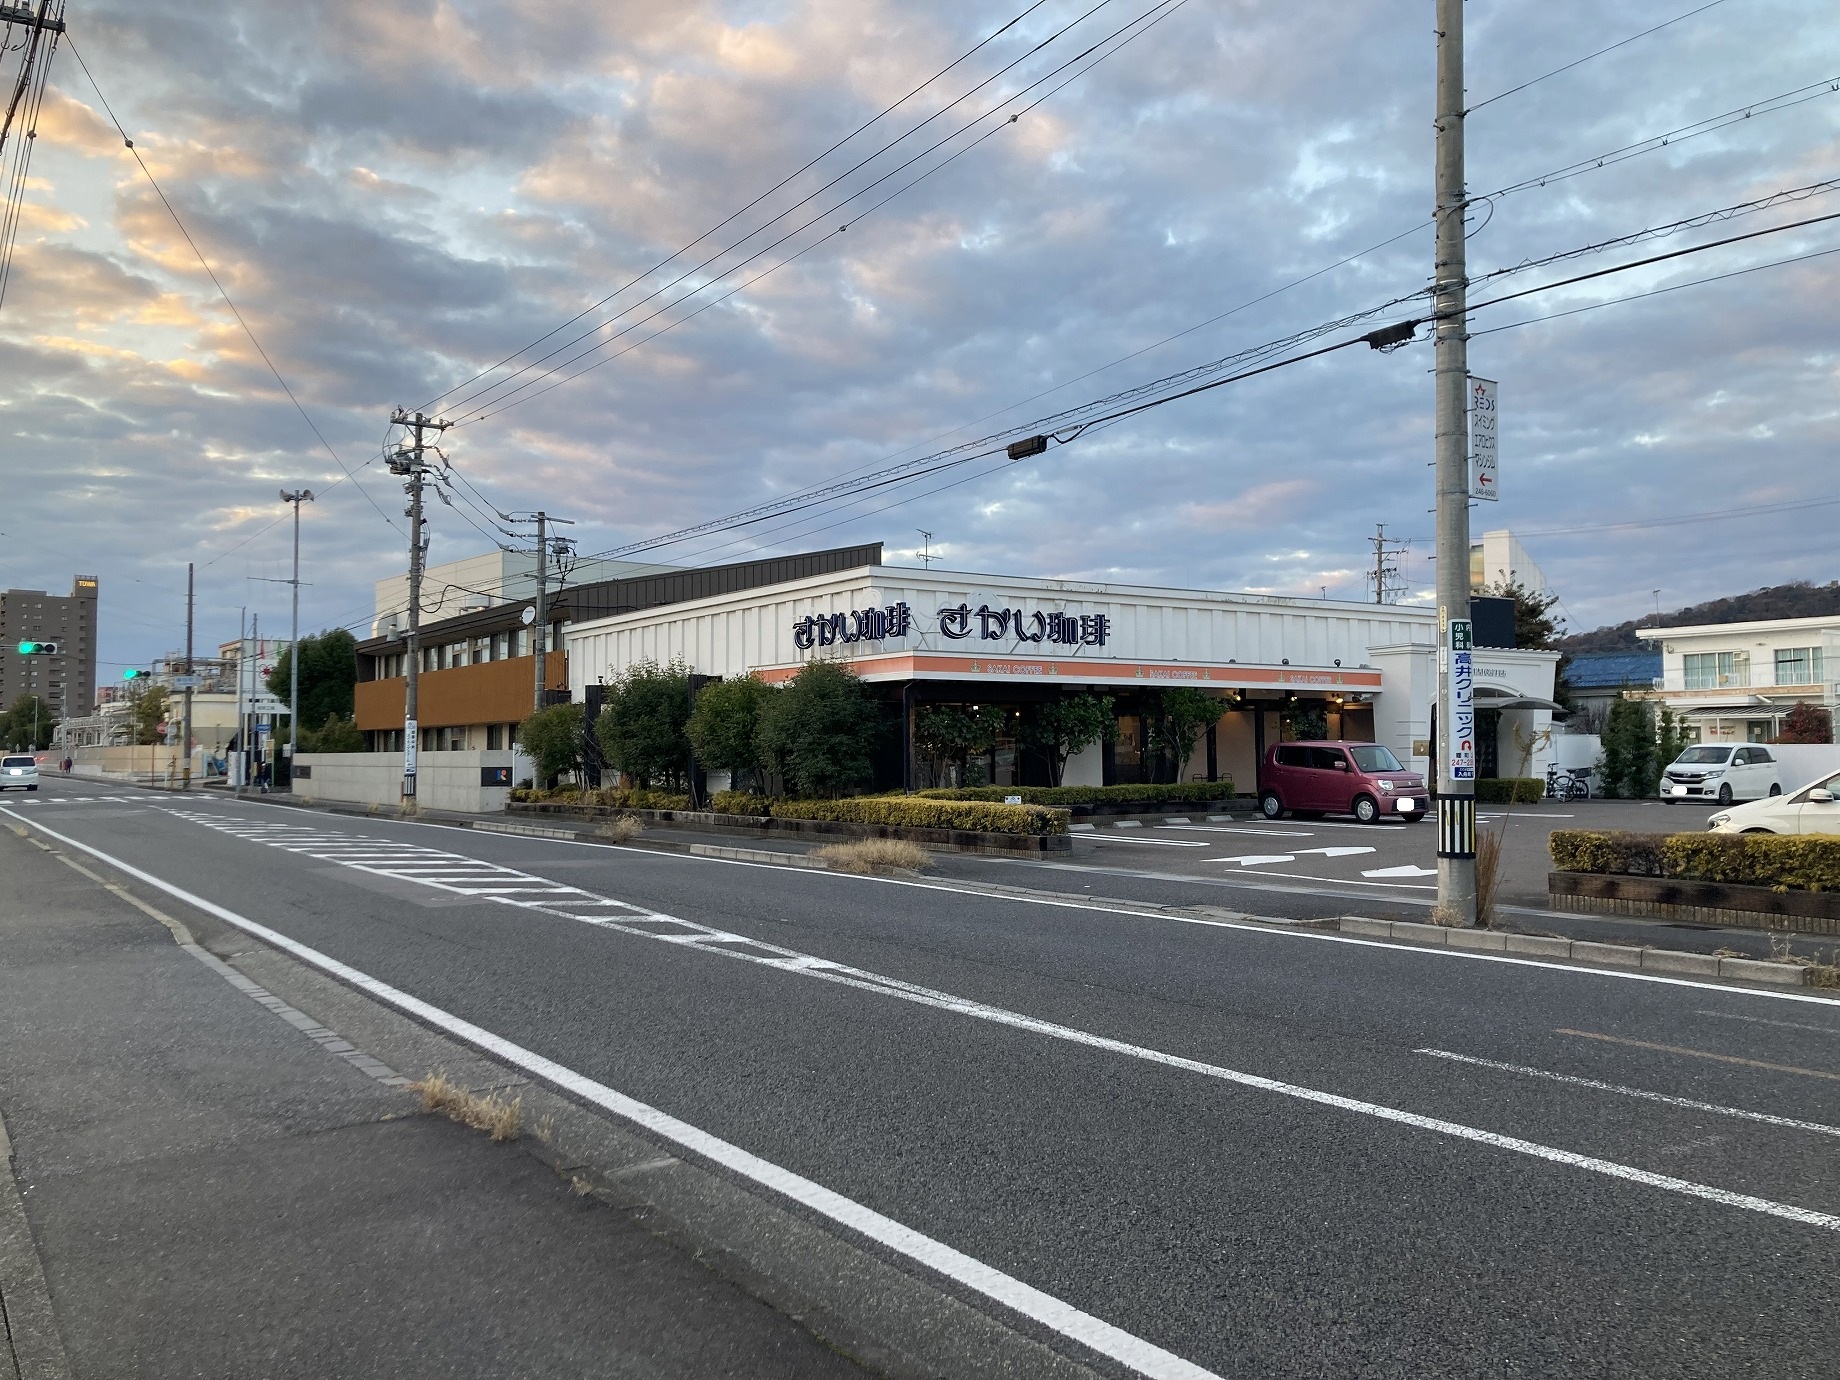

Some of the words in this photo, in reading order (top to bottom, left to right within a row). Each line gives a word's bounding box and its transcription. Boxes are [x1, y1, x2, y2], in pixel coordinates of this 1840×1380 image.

[1474, 414, 1495, 430] スイミング
[1474, 453, 1496, 469] マシンジム
[792, 601, 911, 650] さかい珈琲
[936, 602, 1111, 646] さかい珈琲
[1454, 623, 1464, 649] 小児科
[987, 664, 1010, 674] SAKAI
[1013, 665, 1042, 675] COFFEE
[1455, 652, 1473, 739] 高井クリニック
